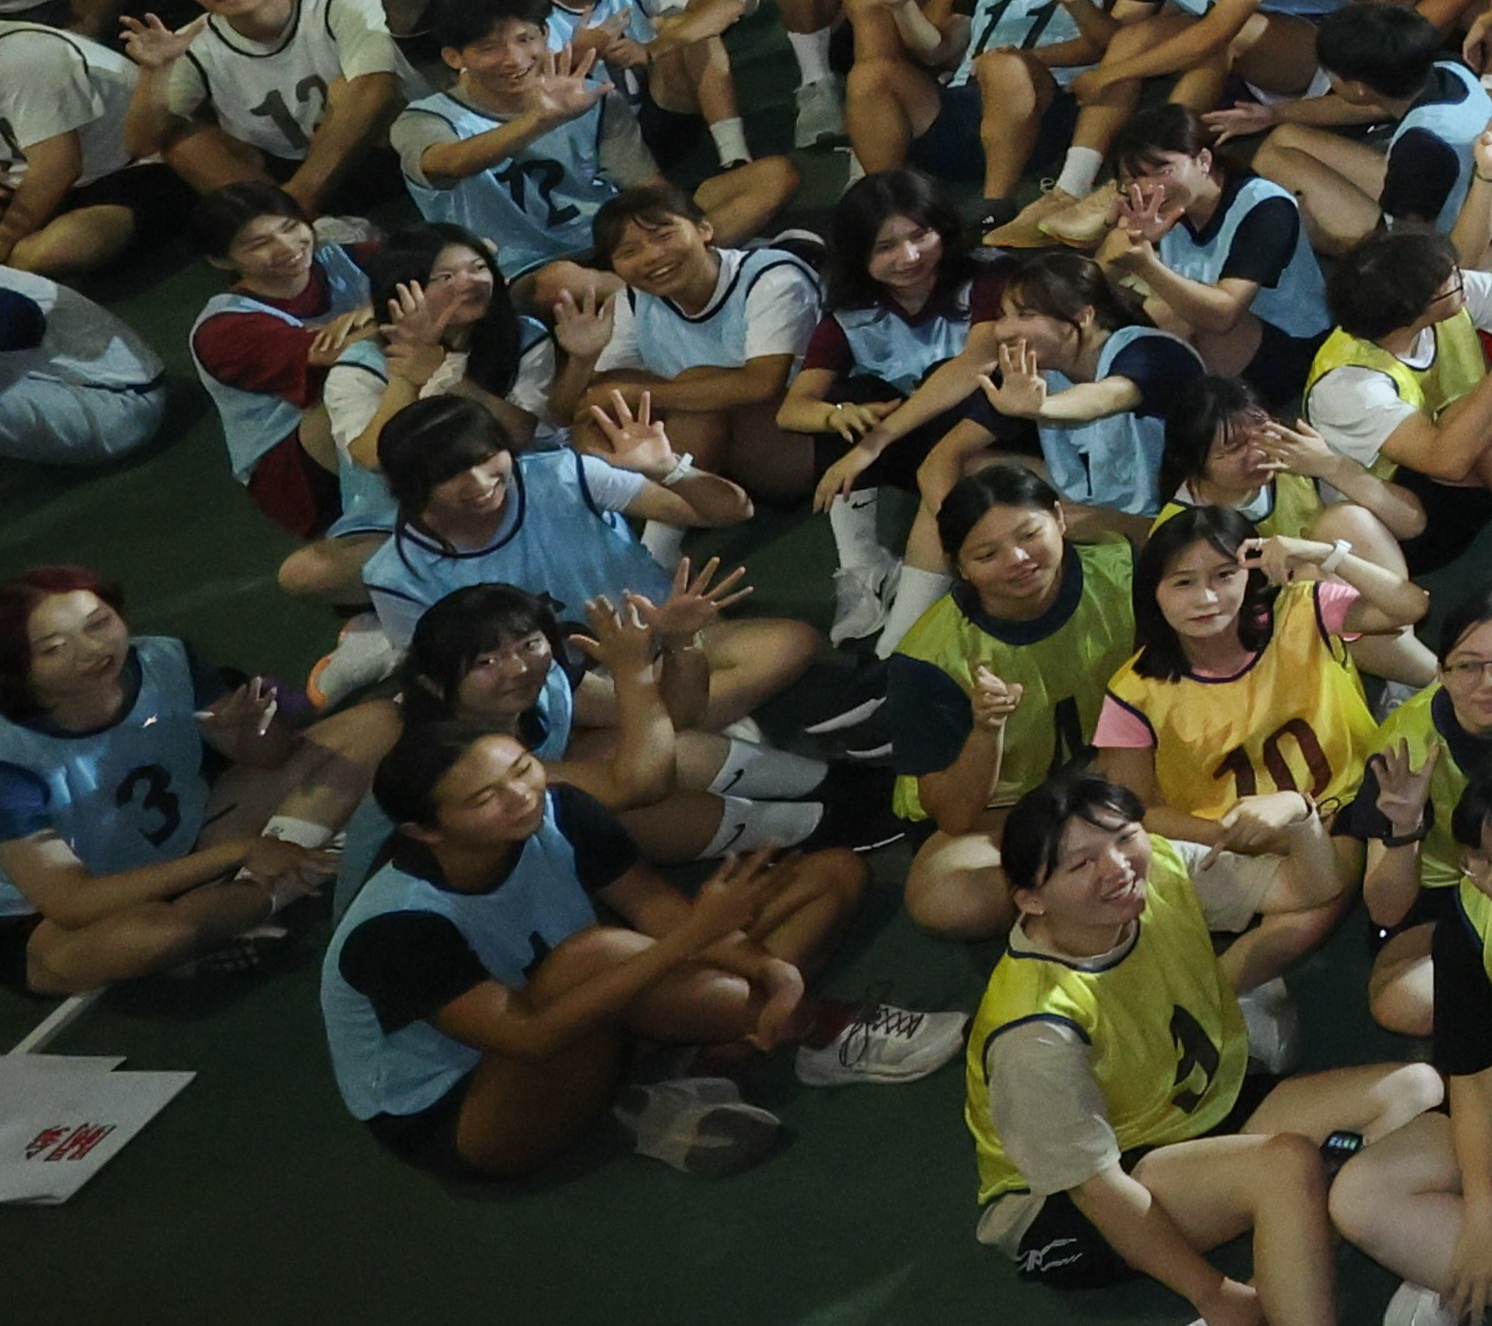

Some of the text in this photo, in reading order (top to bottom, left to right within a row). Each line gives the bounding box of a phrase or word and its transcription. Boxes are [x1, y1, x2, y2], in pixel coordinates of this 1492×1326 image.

[495, 158, 580, 227] 12
[1213, 718, 1333, 798] 10
[116, 765, 182, 847] 3
